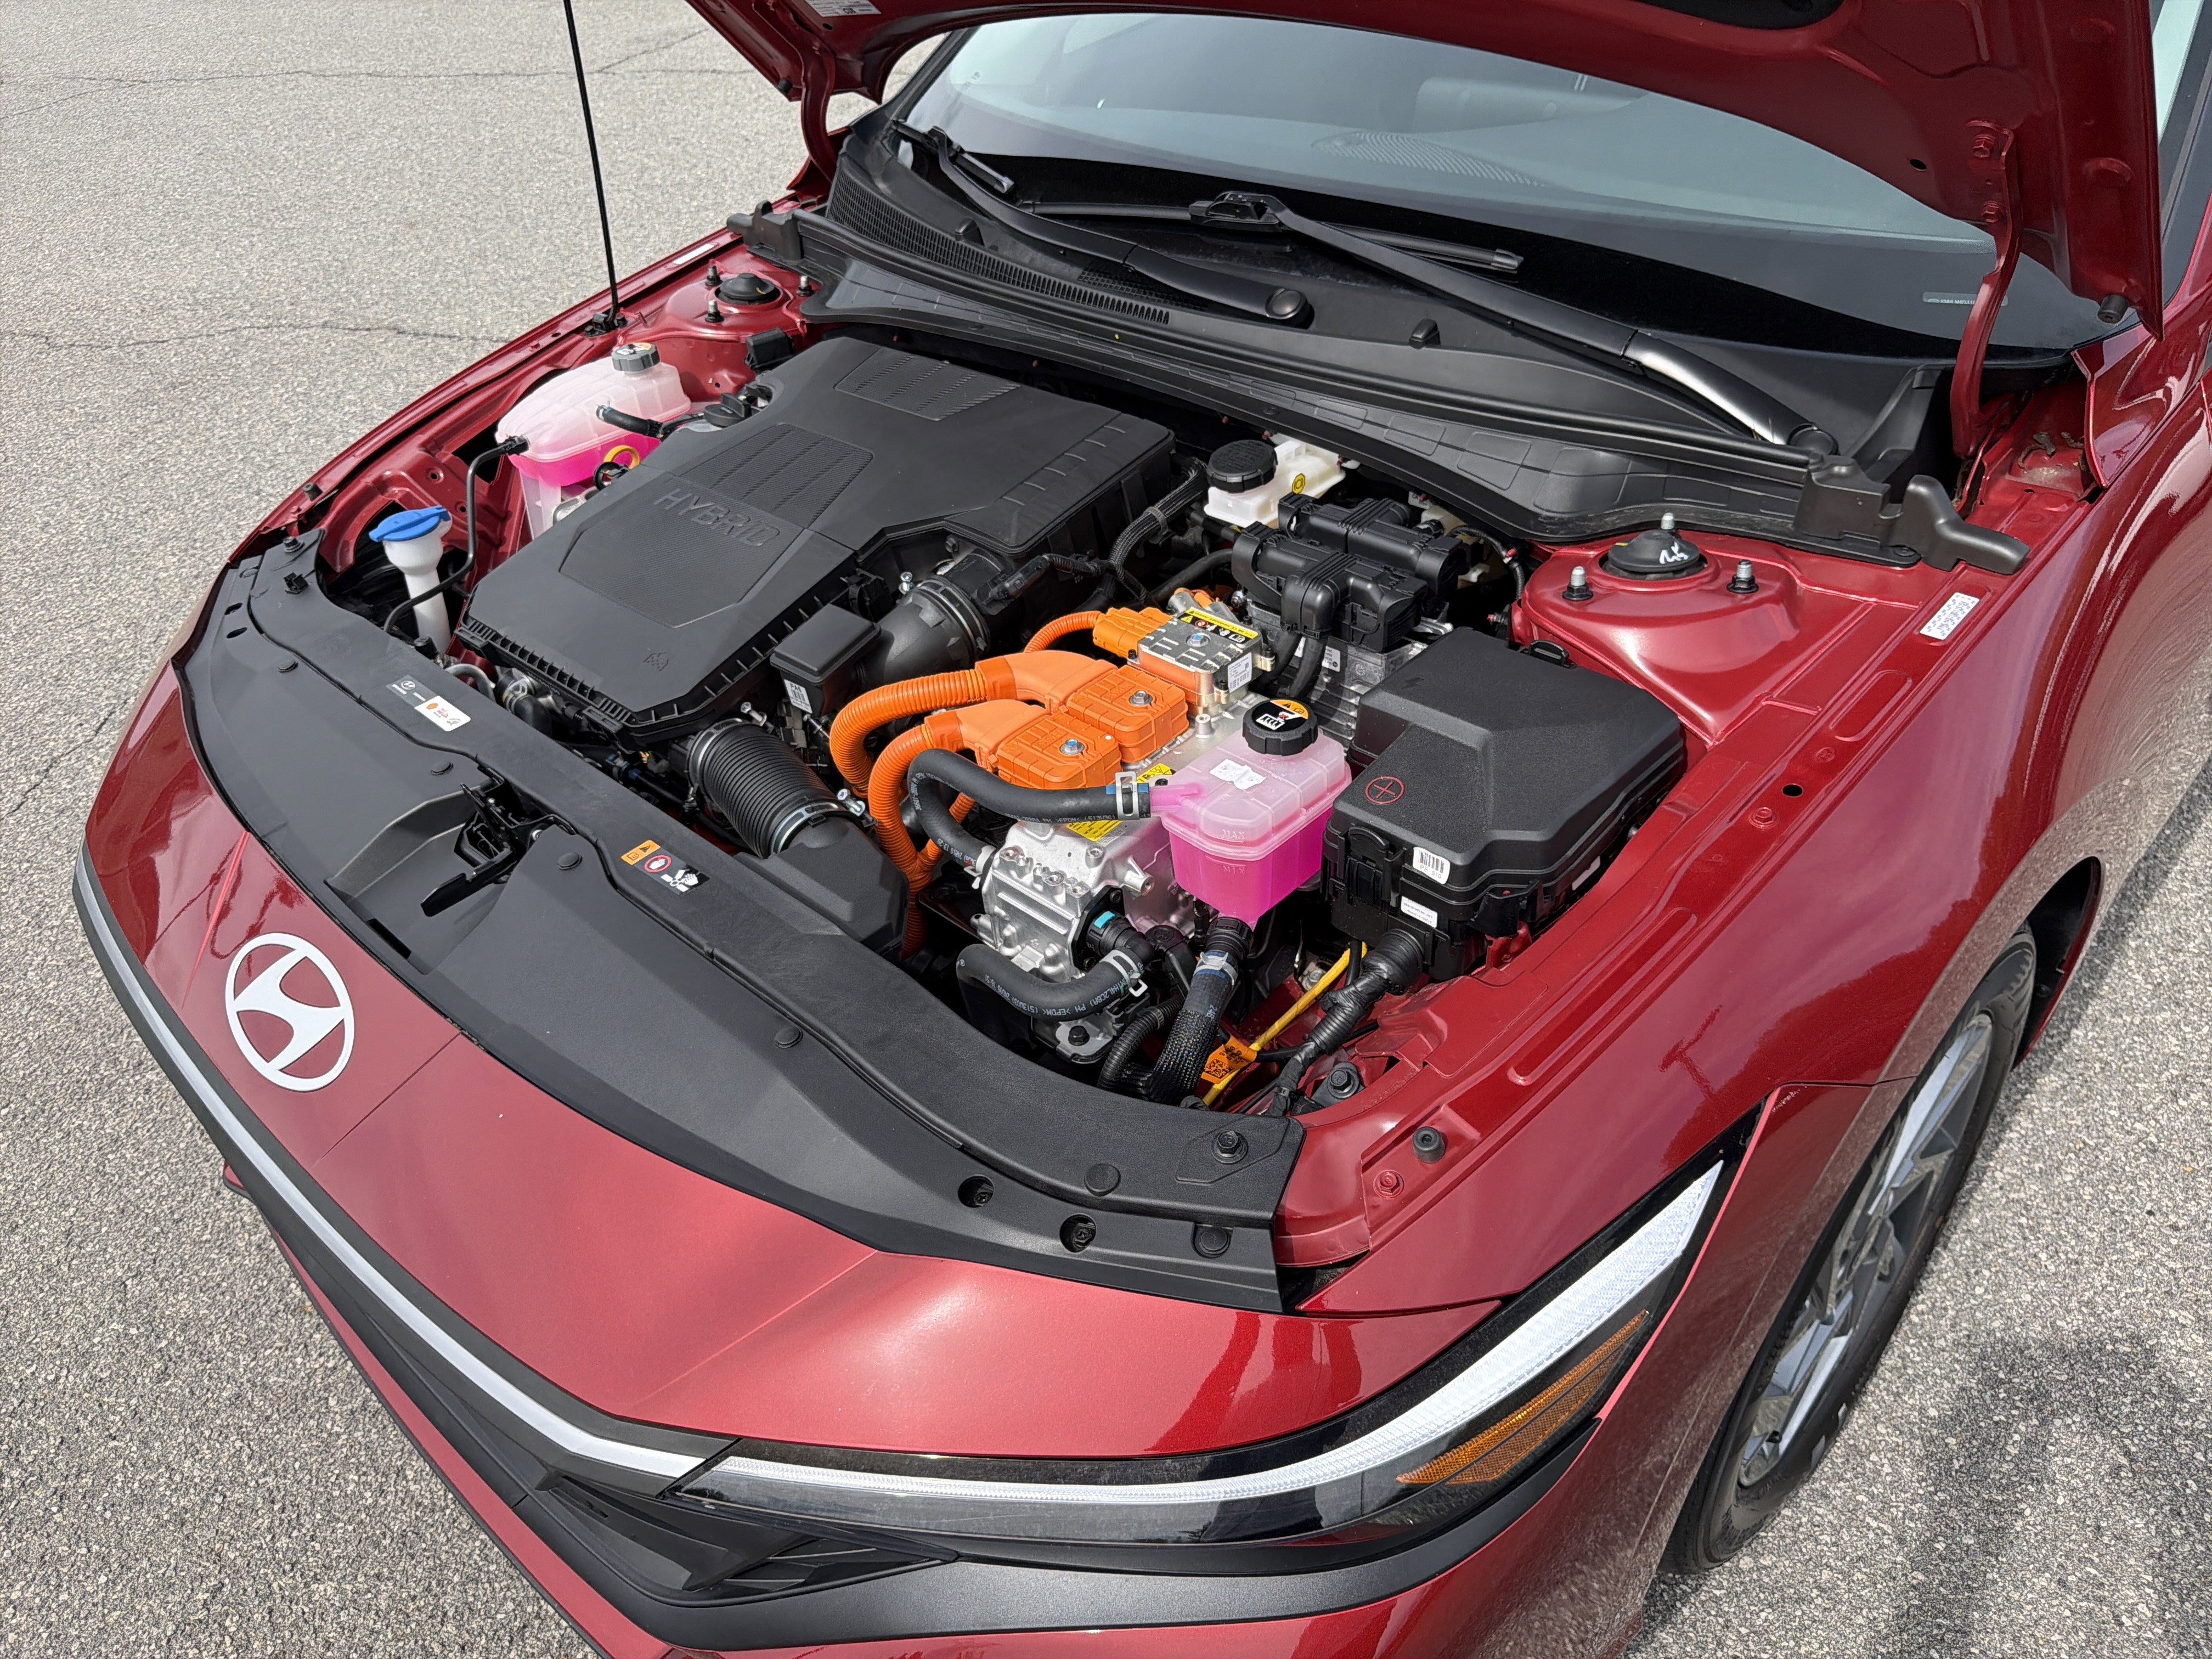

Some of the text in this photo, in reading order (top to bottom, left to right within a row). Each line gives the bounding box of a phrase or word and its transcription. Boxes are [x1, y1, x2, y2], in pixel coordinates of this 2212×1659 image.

[653, 488, 780, 546] HYBRID
[1221, 828, 1245, 839] MAX
[1222, 865, 1245, 875] MIN
[1420, 864, 1429, 873] PE
[1042, 1008, 1071, 1017] >EPDM<
[1074, 1003, 1086, 1013] PH
